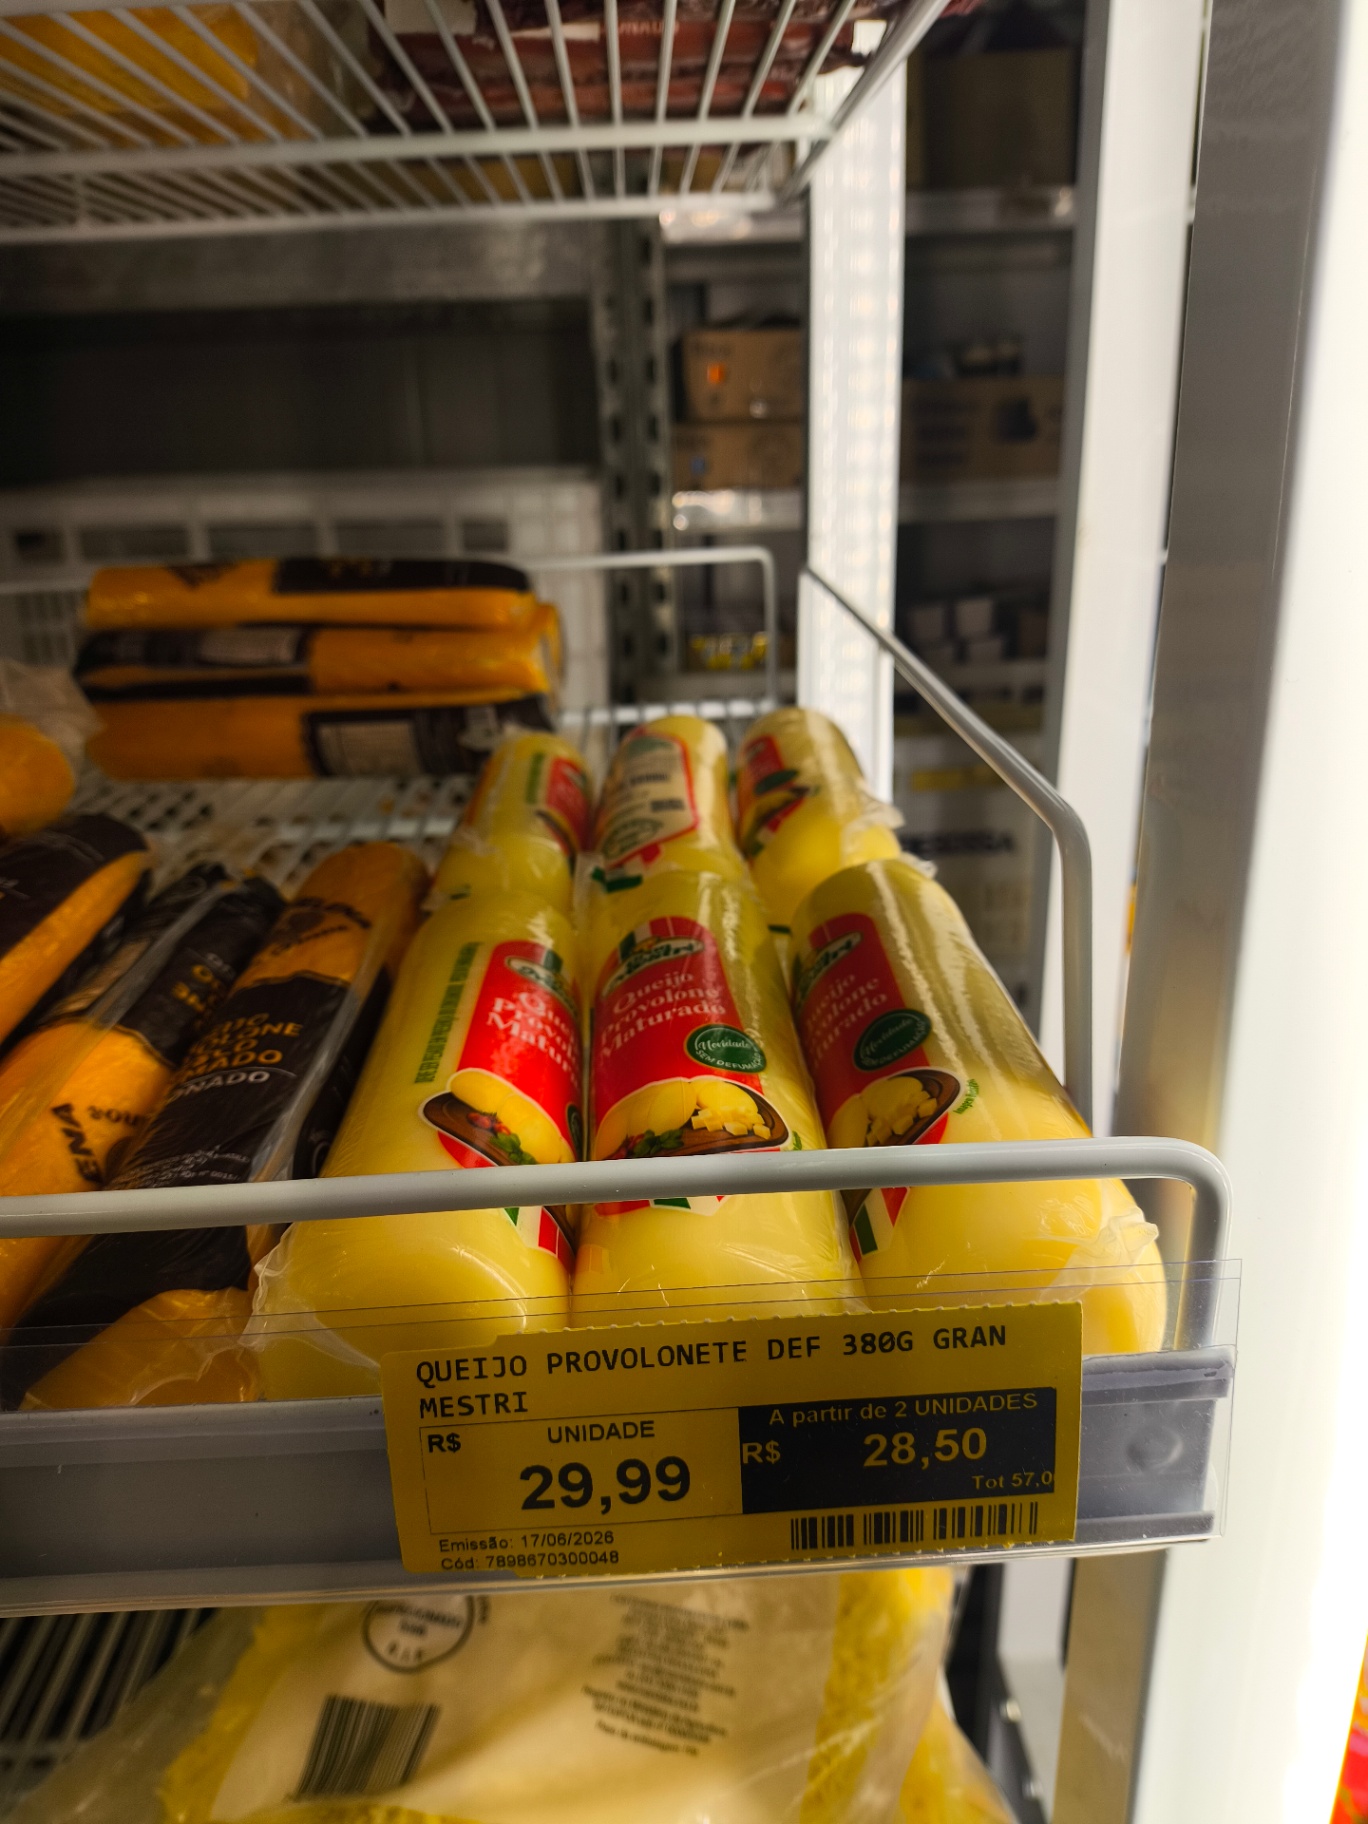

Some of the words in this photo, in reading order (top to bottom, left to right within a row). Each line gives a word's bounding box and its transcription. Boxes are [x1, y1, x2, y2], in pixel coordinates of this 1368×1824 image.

[614, 970, 695, 1014] Queijo
[601, 984, 721, 1046] Provolone
[601, 1000, 727, 1058] Maturado
[695, 1049, 717, 1064] SEM
[697, 1038, 753, 1052] Novidade
[416, 1354, 528, 1389] QUEIJO
[547, 1340, 747, 1375] PROVOLONETE
[767, 1336, 821, 1360] DEF
[842, 1330, 914, 1356] 380G
[932, 1325, 1007, 1350] GRAN
[419, 1391, 529, 1419] MESTRI
[769, 1408, 785, 1426] A
[792, 1402, 852, 1428] partir
[860, 1403, 887, 1420] de
[894, 1401, 907, 1418] 2
[915, 1392, 1038, 1417] UNIDADES
[428, 1432, 462, 1454] R$
[547, 1420, 655, 1444] UNIDADE
[742, 1440, 781, 1465] R$
[863, 1427, 988, 1470] 28,50
[519, 1456, 691, 1516] 29,99
[971, 1474, 1005, 1490] Tot
[439, 1535, 514, 1553] Emissão:
[520, 1530, 615, 1549] 17/06/2026
[441, 1555, 480, 1571] Cód:
[486, 1550, 620, 1569] 7898670300048
